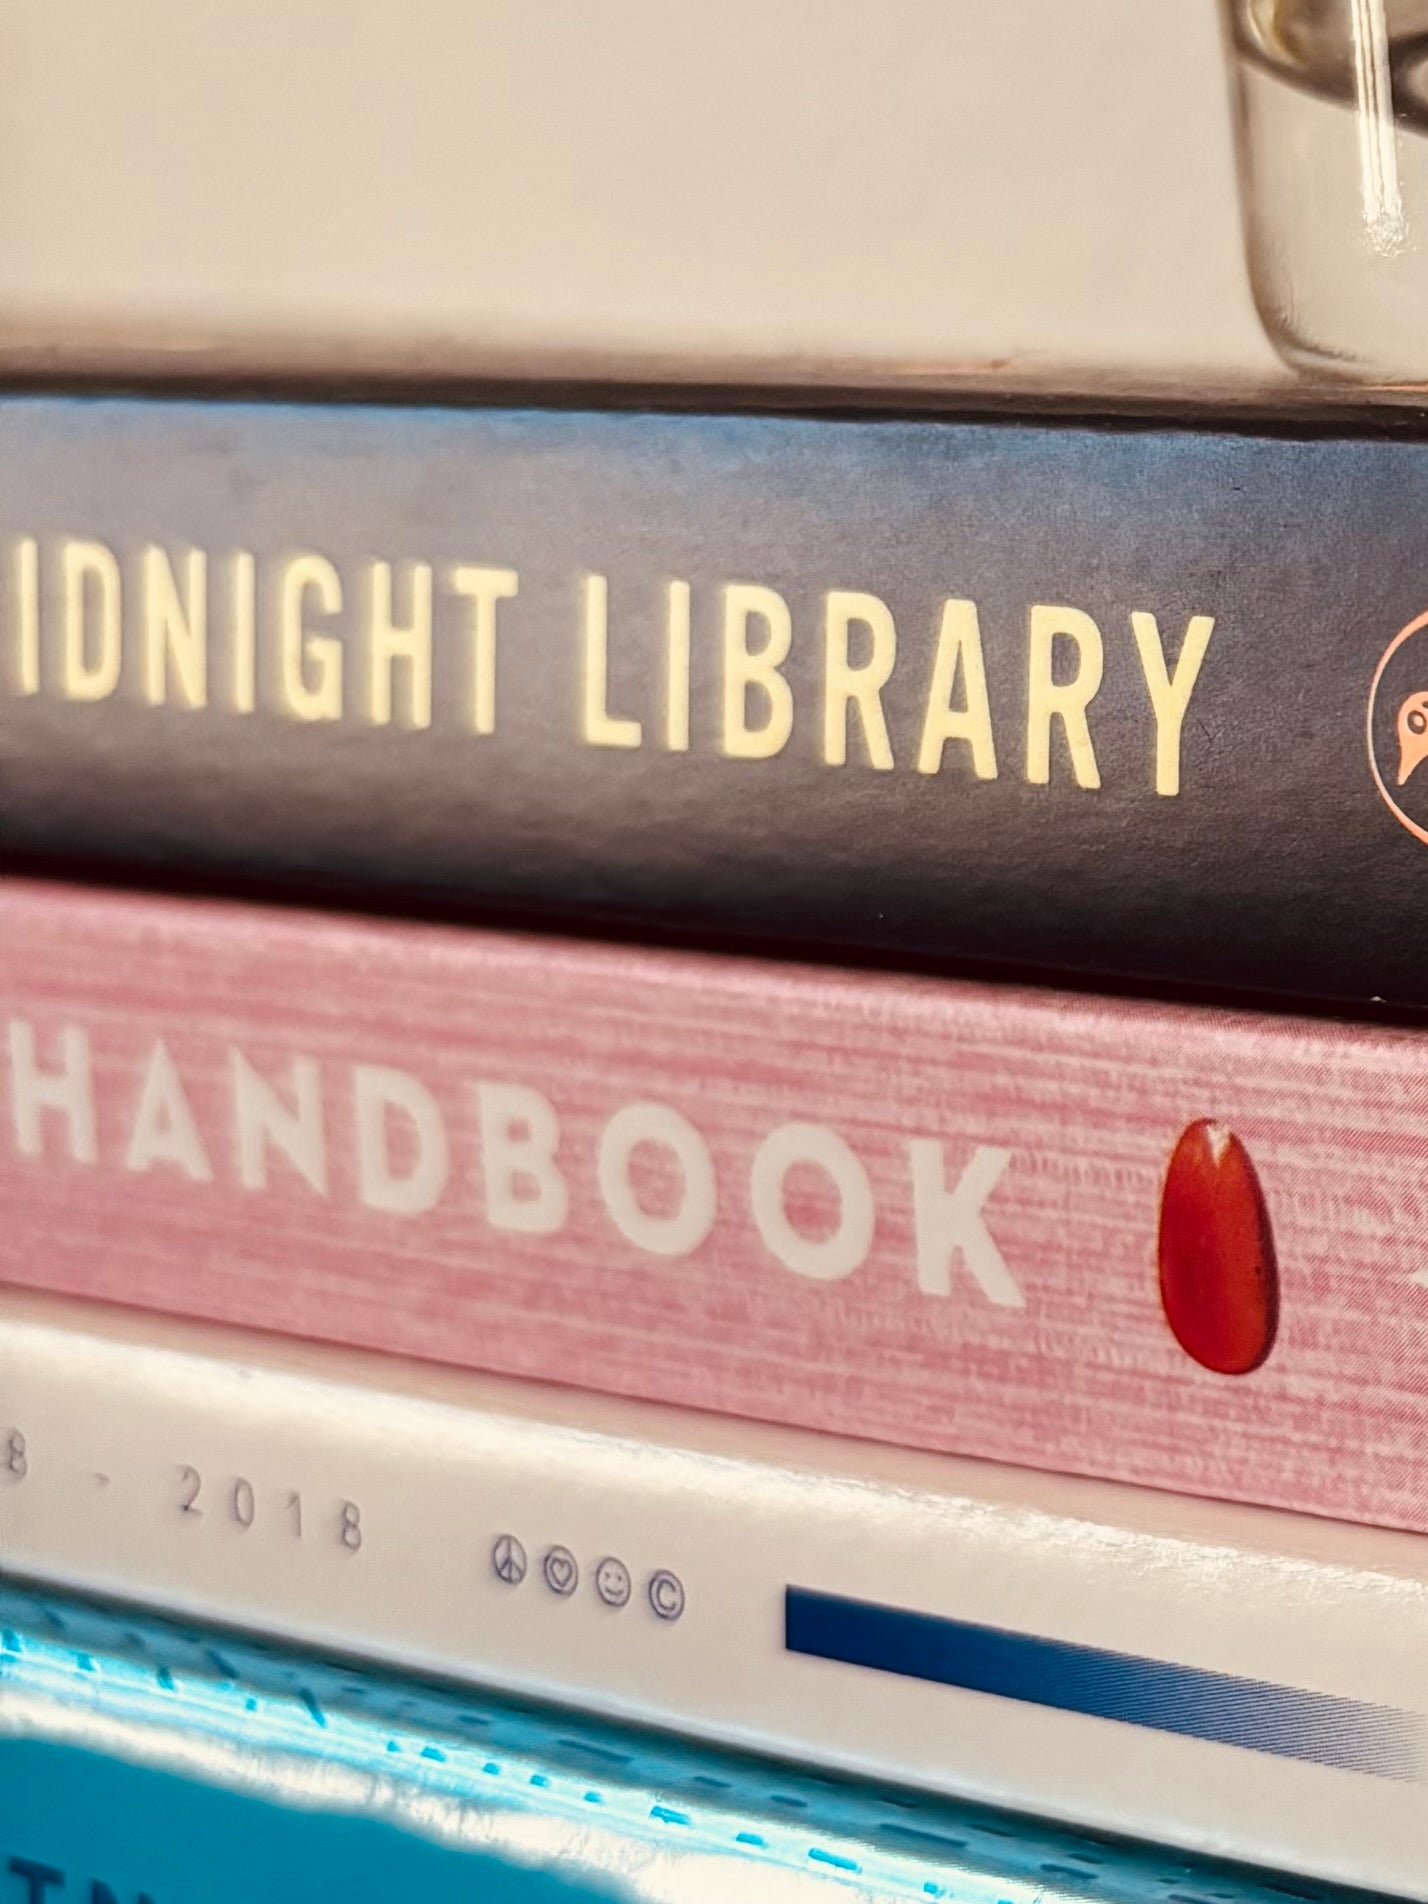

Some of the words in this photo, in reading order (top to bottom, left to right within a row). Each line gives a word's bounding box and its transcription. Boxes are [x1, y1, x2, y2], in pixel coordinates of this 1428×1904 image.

[16, 535, 520, 736] IDNIGHT
[585, 574, 1216, 796] LIBRARY
[8, 1018, 1026, 1308] HANDBOOK
[178, 1465, 363, 1552] 2018
